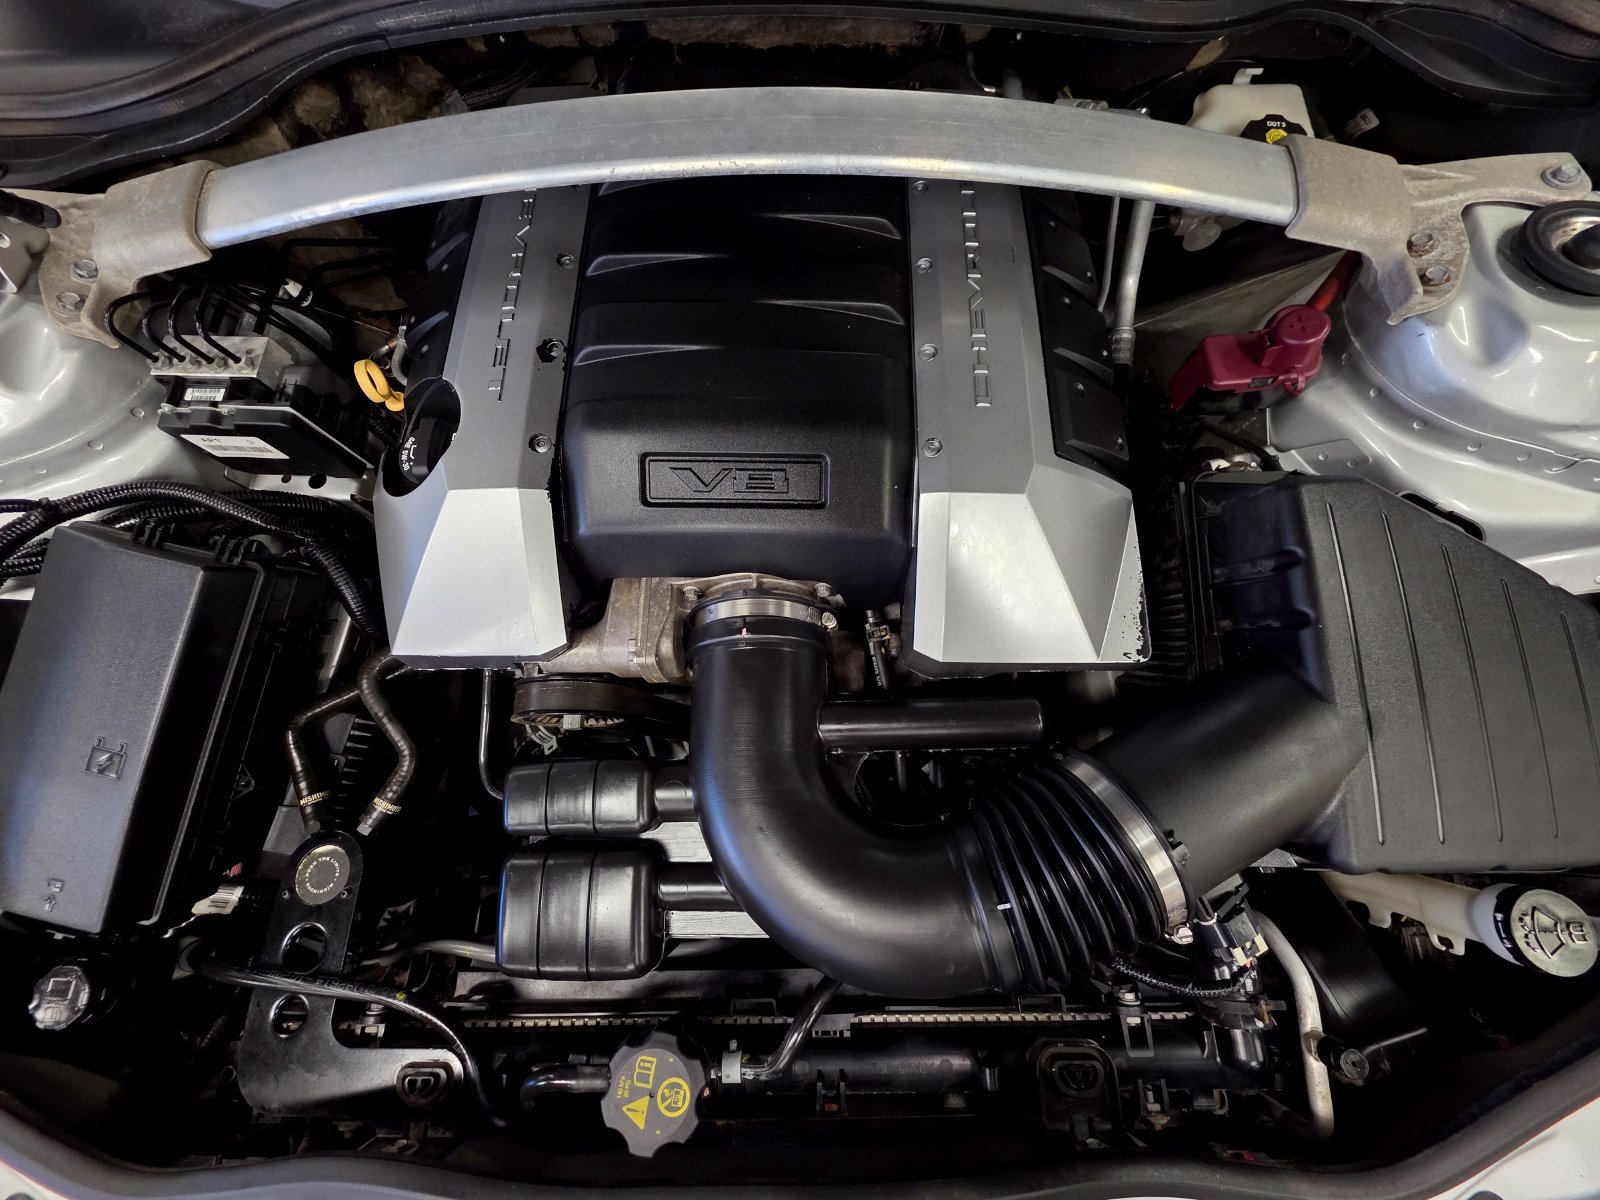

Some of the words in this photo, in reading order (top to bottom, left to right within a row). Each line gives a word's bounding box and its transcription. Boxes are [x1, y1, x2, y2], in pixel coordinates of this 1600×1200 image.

[488, 190, 537, 402] EVROLET
[960, 180, 992, 407] CHEVROLE
[401, 449, 410, 471] 5W-30
[669, 466, 789, 494] V8
